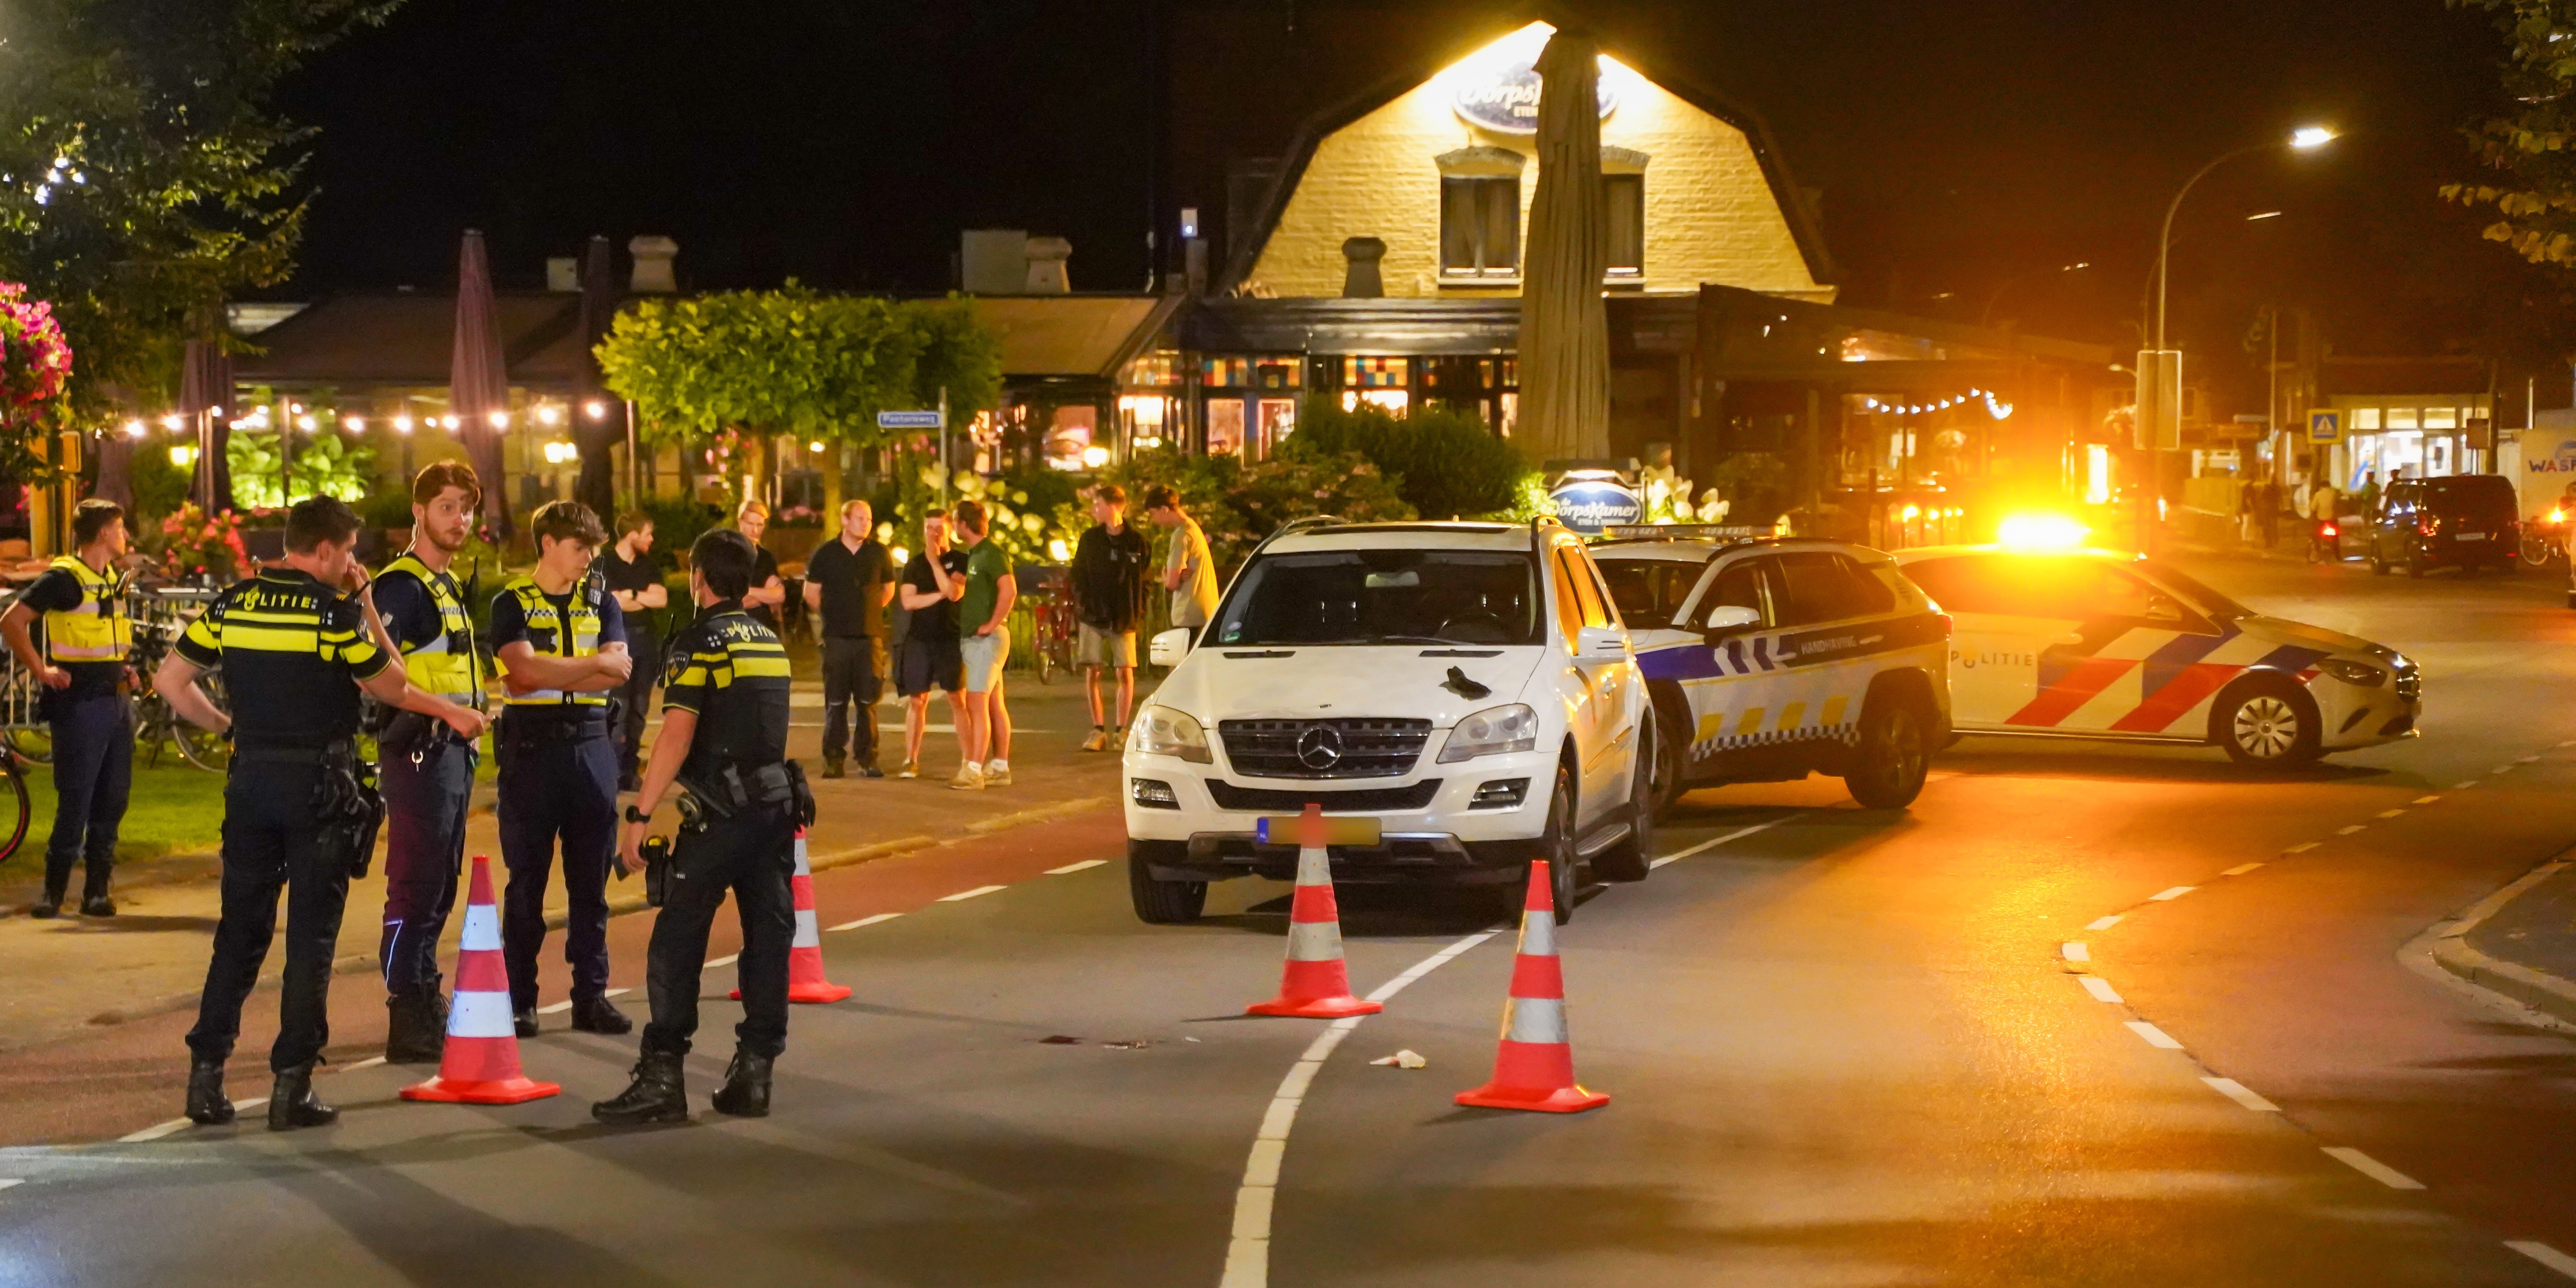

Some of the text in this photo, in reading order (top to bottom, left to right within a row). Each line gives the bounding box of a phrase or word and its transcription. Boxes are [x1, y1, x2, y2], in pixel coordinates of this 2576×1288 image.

[235, 587, 312, 611] POLITIE
[1801, 635, 1857, 655] HANDHAVING
[1950, 650, 2033, 669] POLITIE
